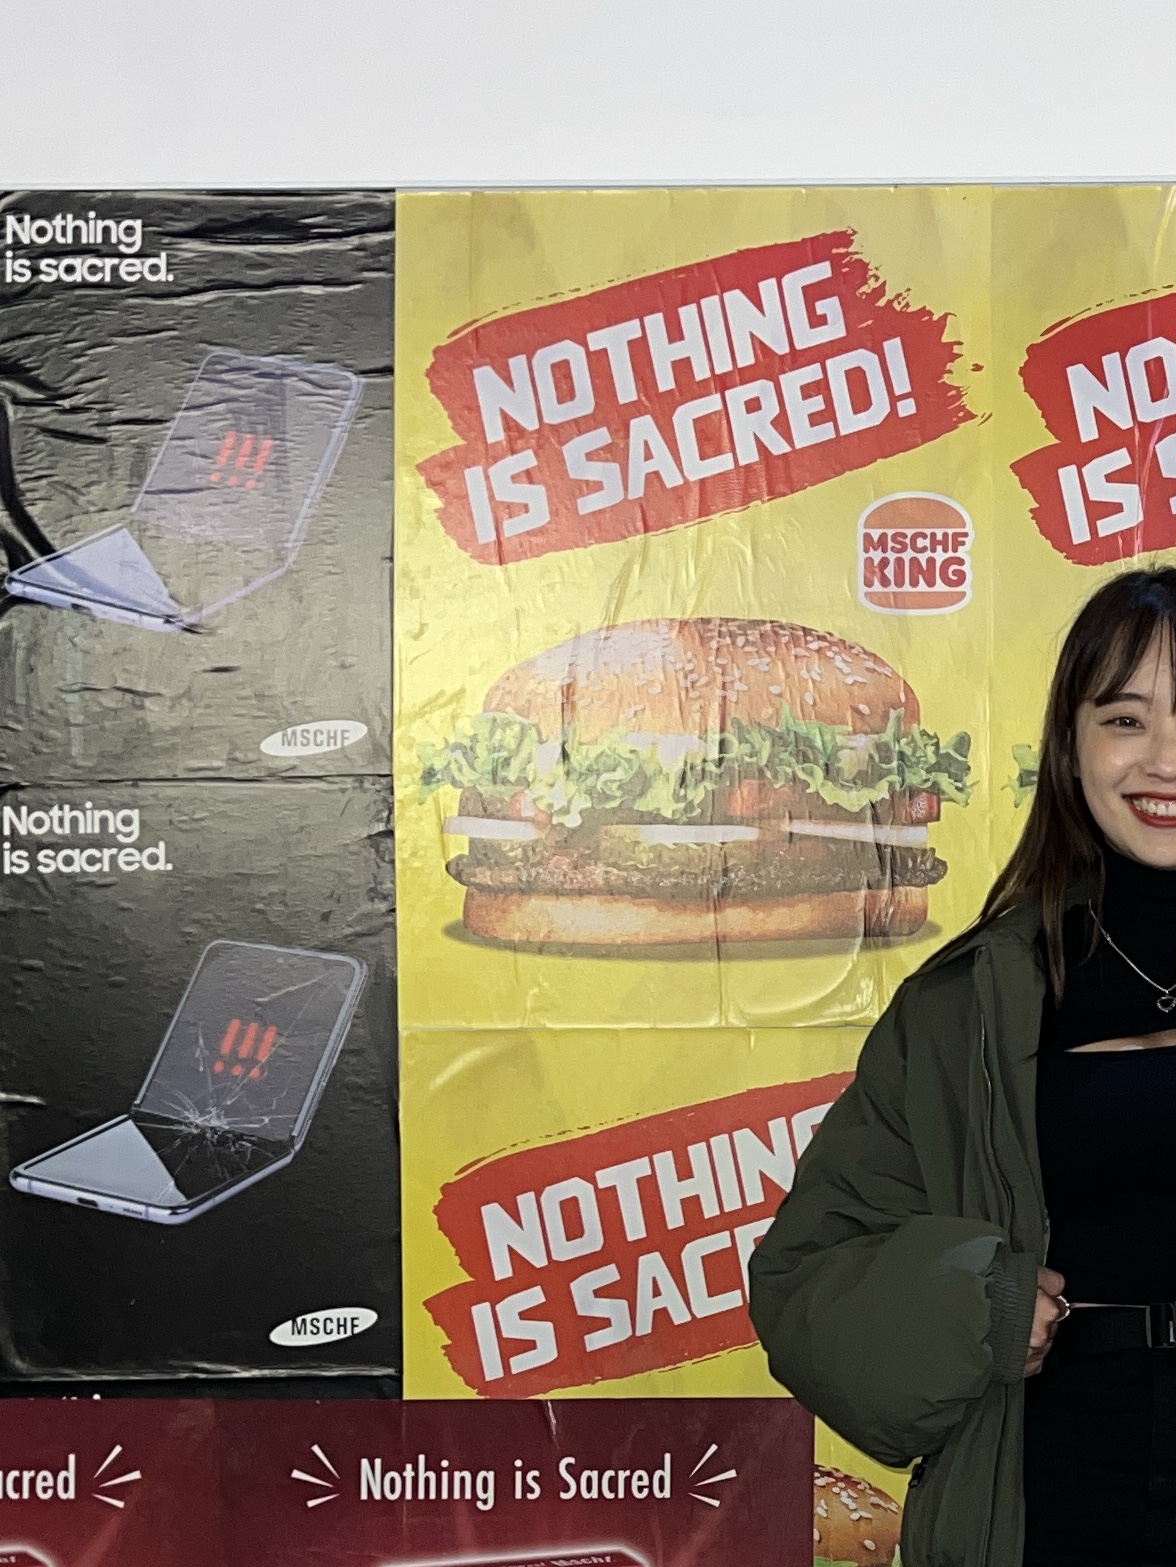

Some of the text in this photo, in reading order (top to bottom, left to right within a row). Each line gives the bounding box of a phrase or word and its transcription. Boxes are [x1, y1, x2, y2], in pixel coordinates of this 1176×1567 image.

[5, 212, 142, 254] Nothing
[5, 252, 174, 283] is sacred.
[472, 261, 846, 444] NOTHING
[464, 338, 917, 545] IS SACRED!
[1058, 447, 1144, 544] IS
[863, 531, 968, 554] MSCHF
[863, 556, 967, 589] KING
[281, 729, 351, 748] MSCHF
[3, 801, 139, 843] Nothing
[3, 840, 173, 874] is sacred.
[291, 1316, 361, 1337] MSCHF
[471, 1285, 558, 1382] IS
[0, 1453, 76, 1500] cred
[359, 1452, 671, 1510] Nothing is Sacred
